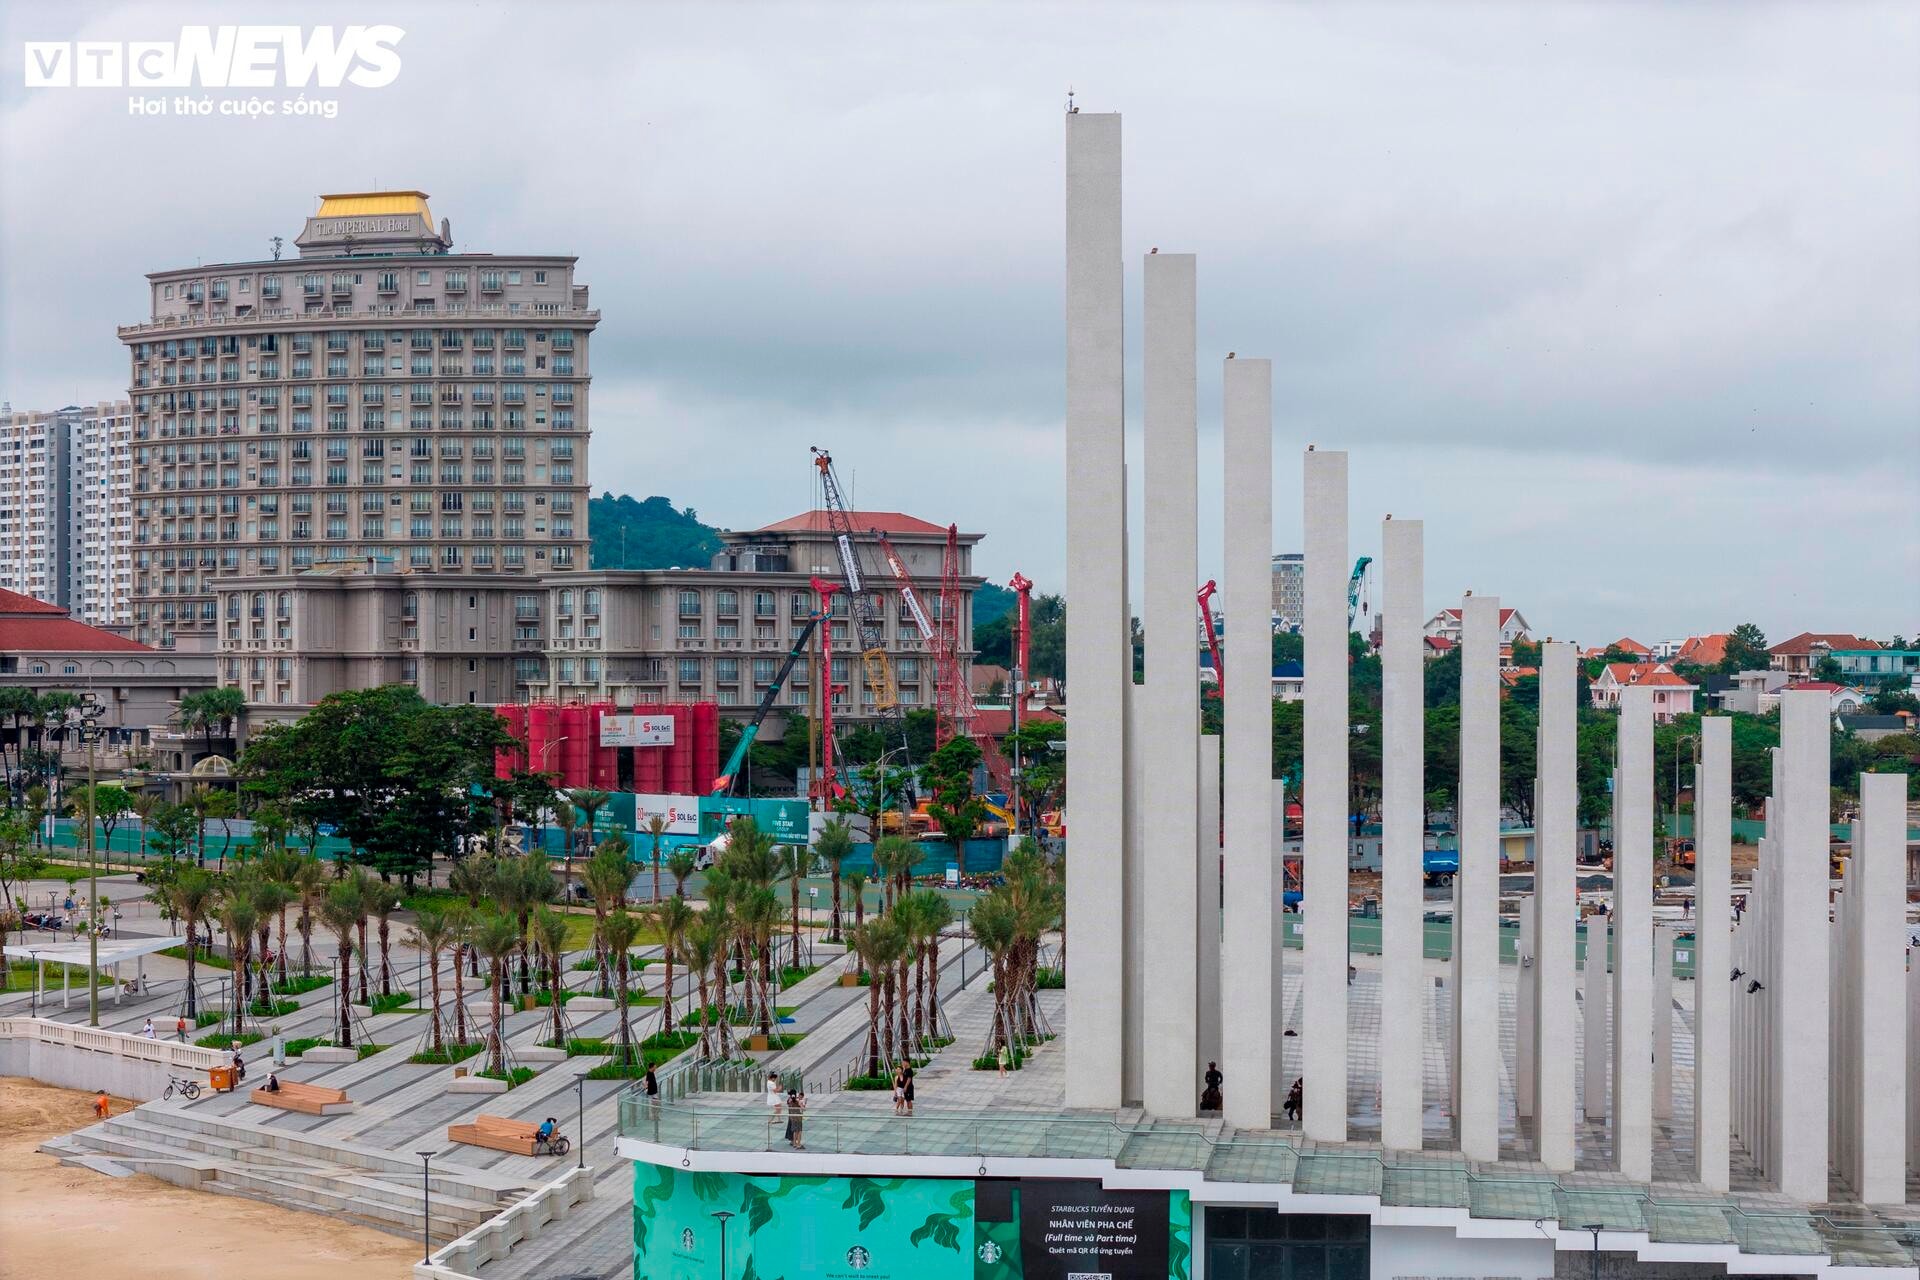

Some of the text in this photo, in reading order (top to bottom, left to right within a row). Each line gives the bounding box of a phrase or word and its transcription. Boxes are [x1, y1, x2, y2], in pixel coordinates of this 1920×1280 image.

[316, 217, 411, 235] The IMPERIAL Hotel
[782, 820, 794, 828] STAR
[1051, 1205, 1089, 1213] STARBUCKS
[1114, 1206, 1135, 1214] DỤNG
[1049, 1219, 1134, 1229] NHÂN VIÊN PHA CHẾ
[1045, 1234, 1063, 1243] (Full
[1064, 1234, 1083, 1242] time
[1084, 1234, 1095, 1242] và
[1115, 1235, 1137, 1244] time)
